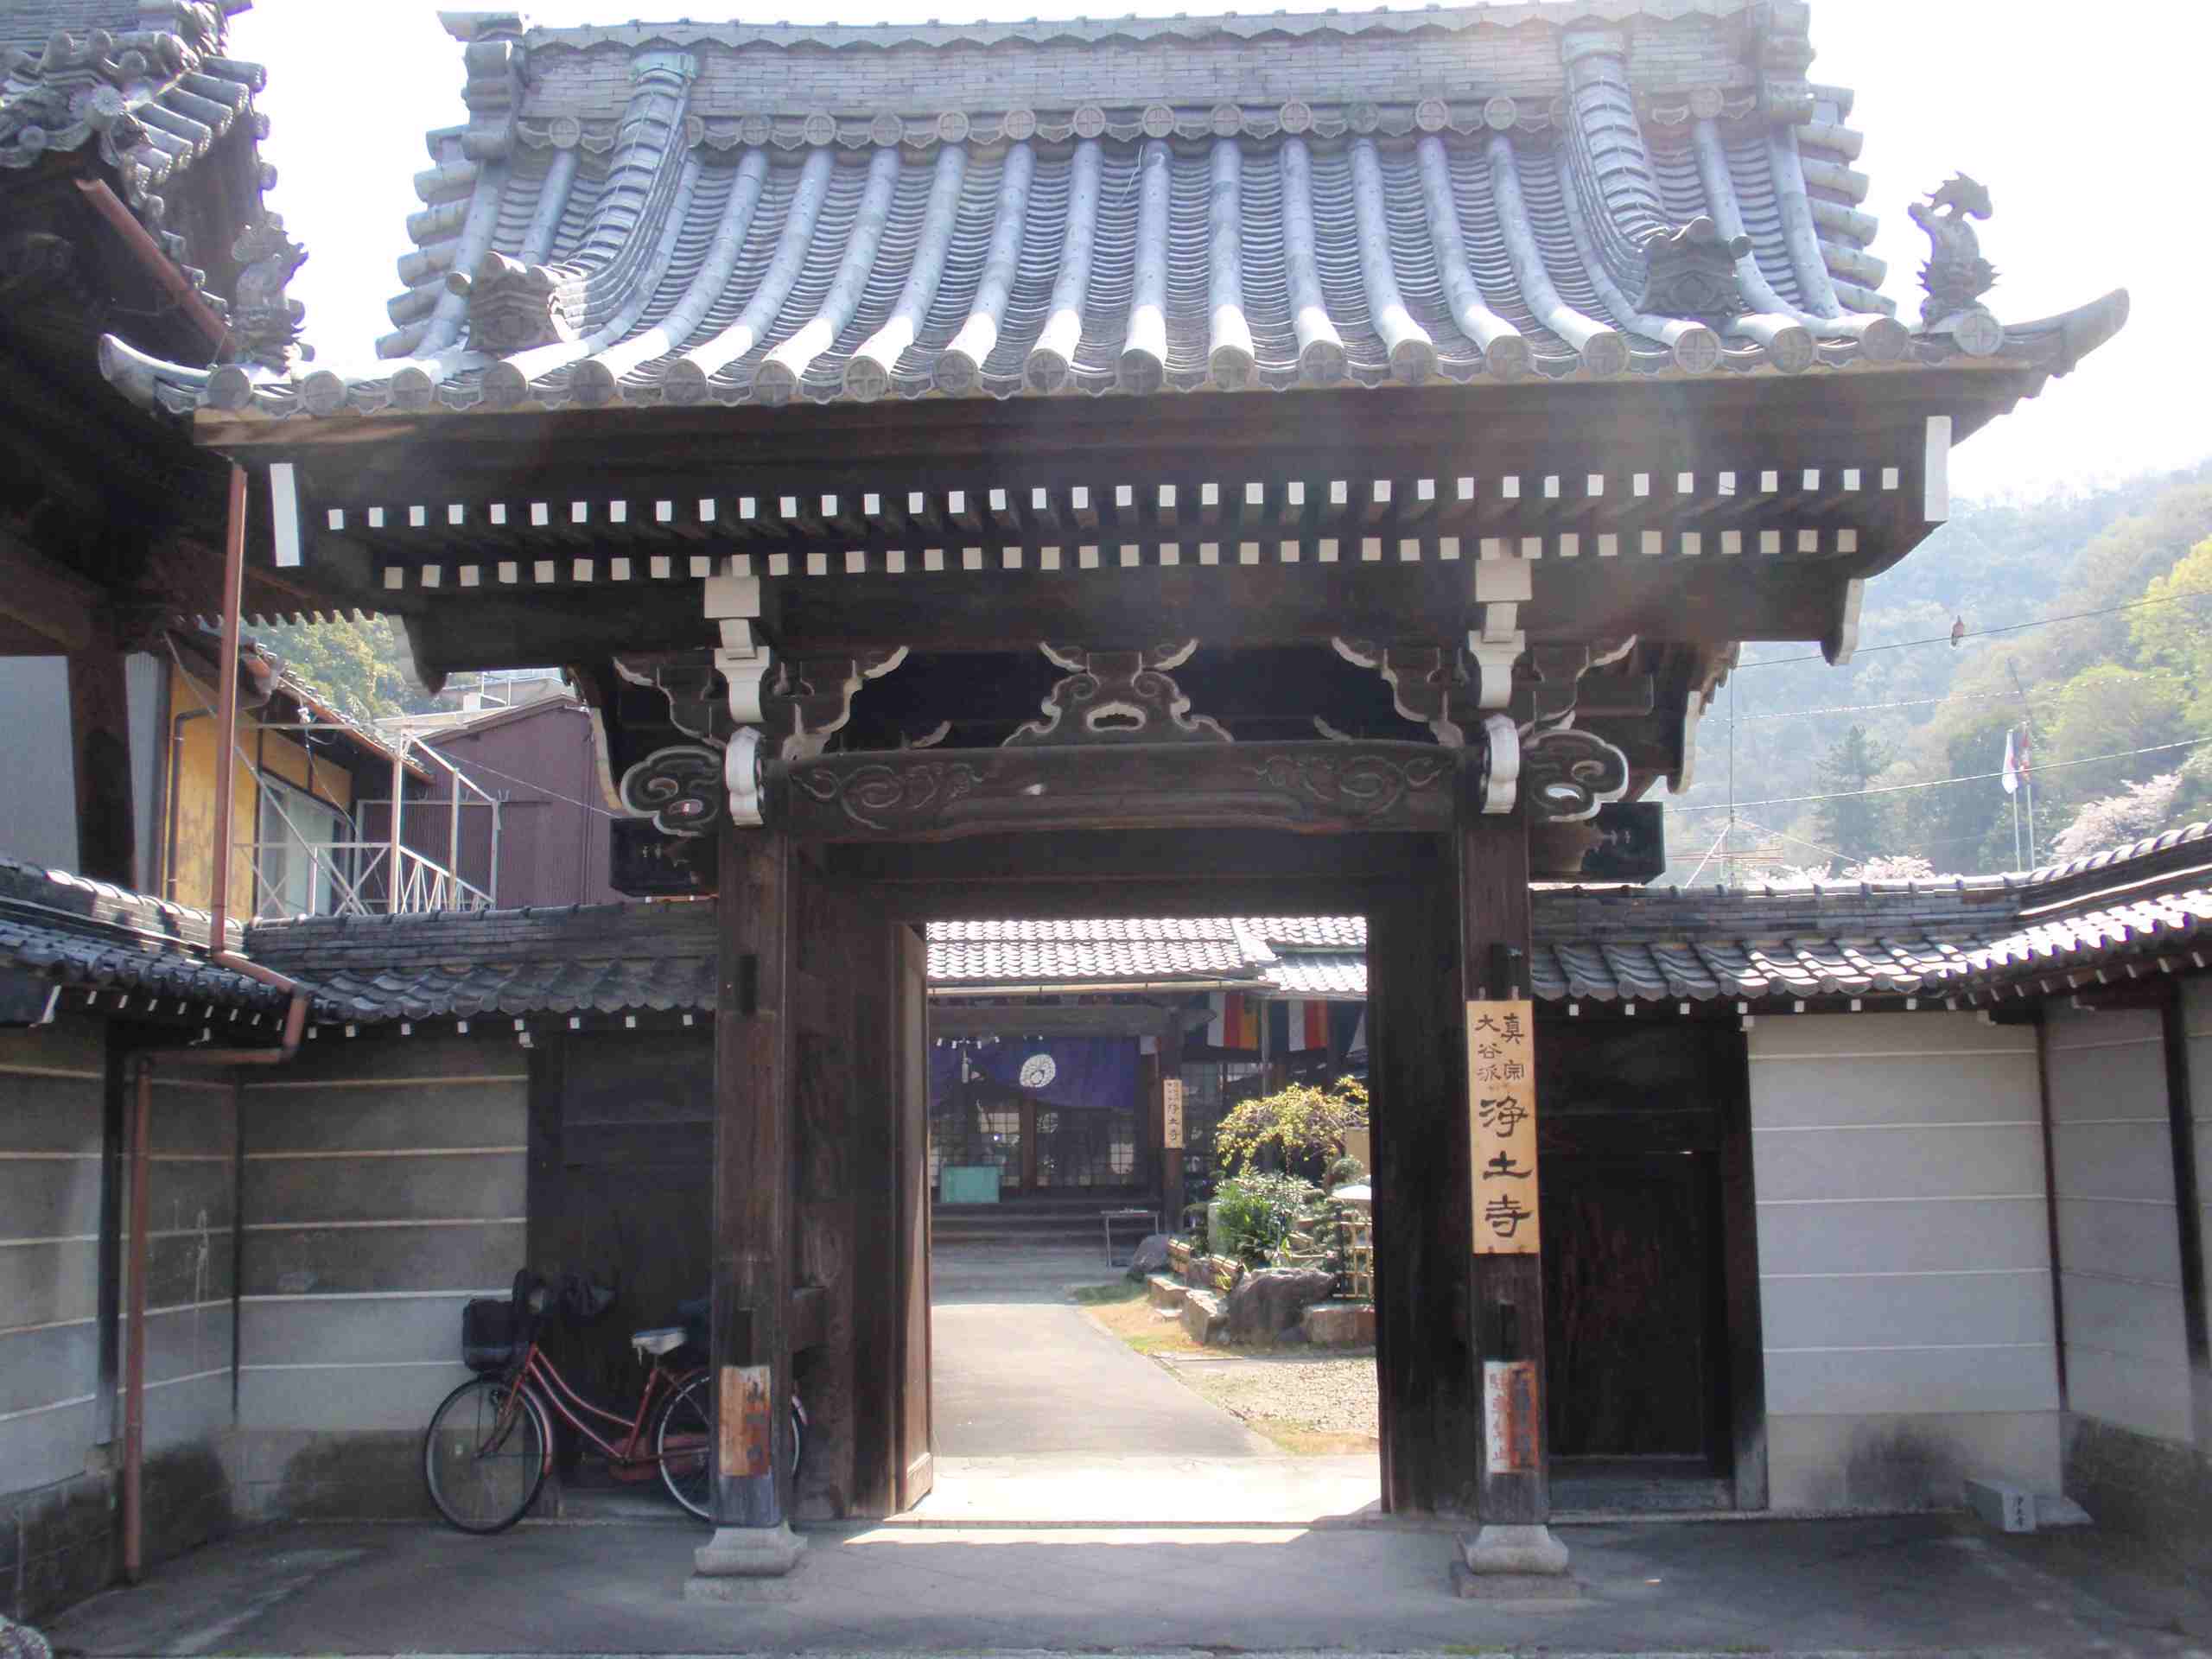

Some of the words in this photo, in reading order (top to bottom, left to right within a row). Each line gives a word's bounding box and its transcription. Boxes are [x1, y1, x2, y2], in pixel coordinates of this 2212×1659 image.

[1474, 1014, 1503, 1083] 大谷派
[1500, 1012, 1525, 1081] 真宗
[1478, 1095, 1533, 1238] 浄土寺
